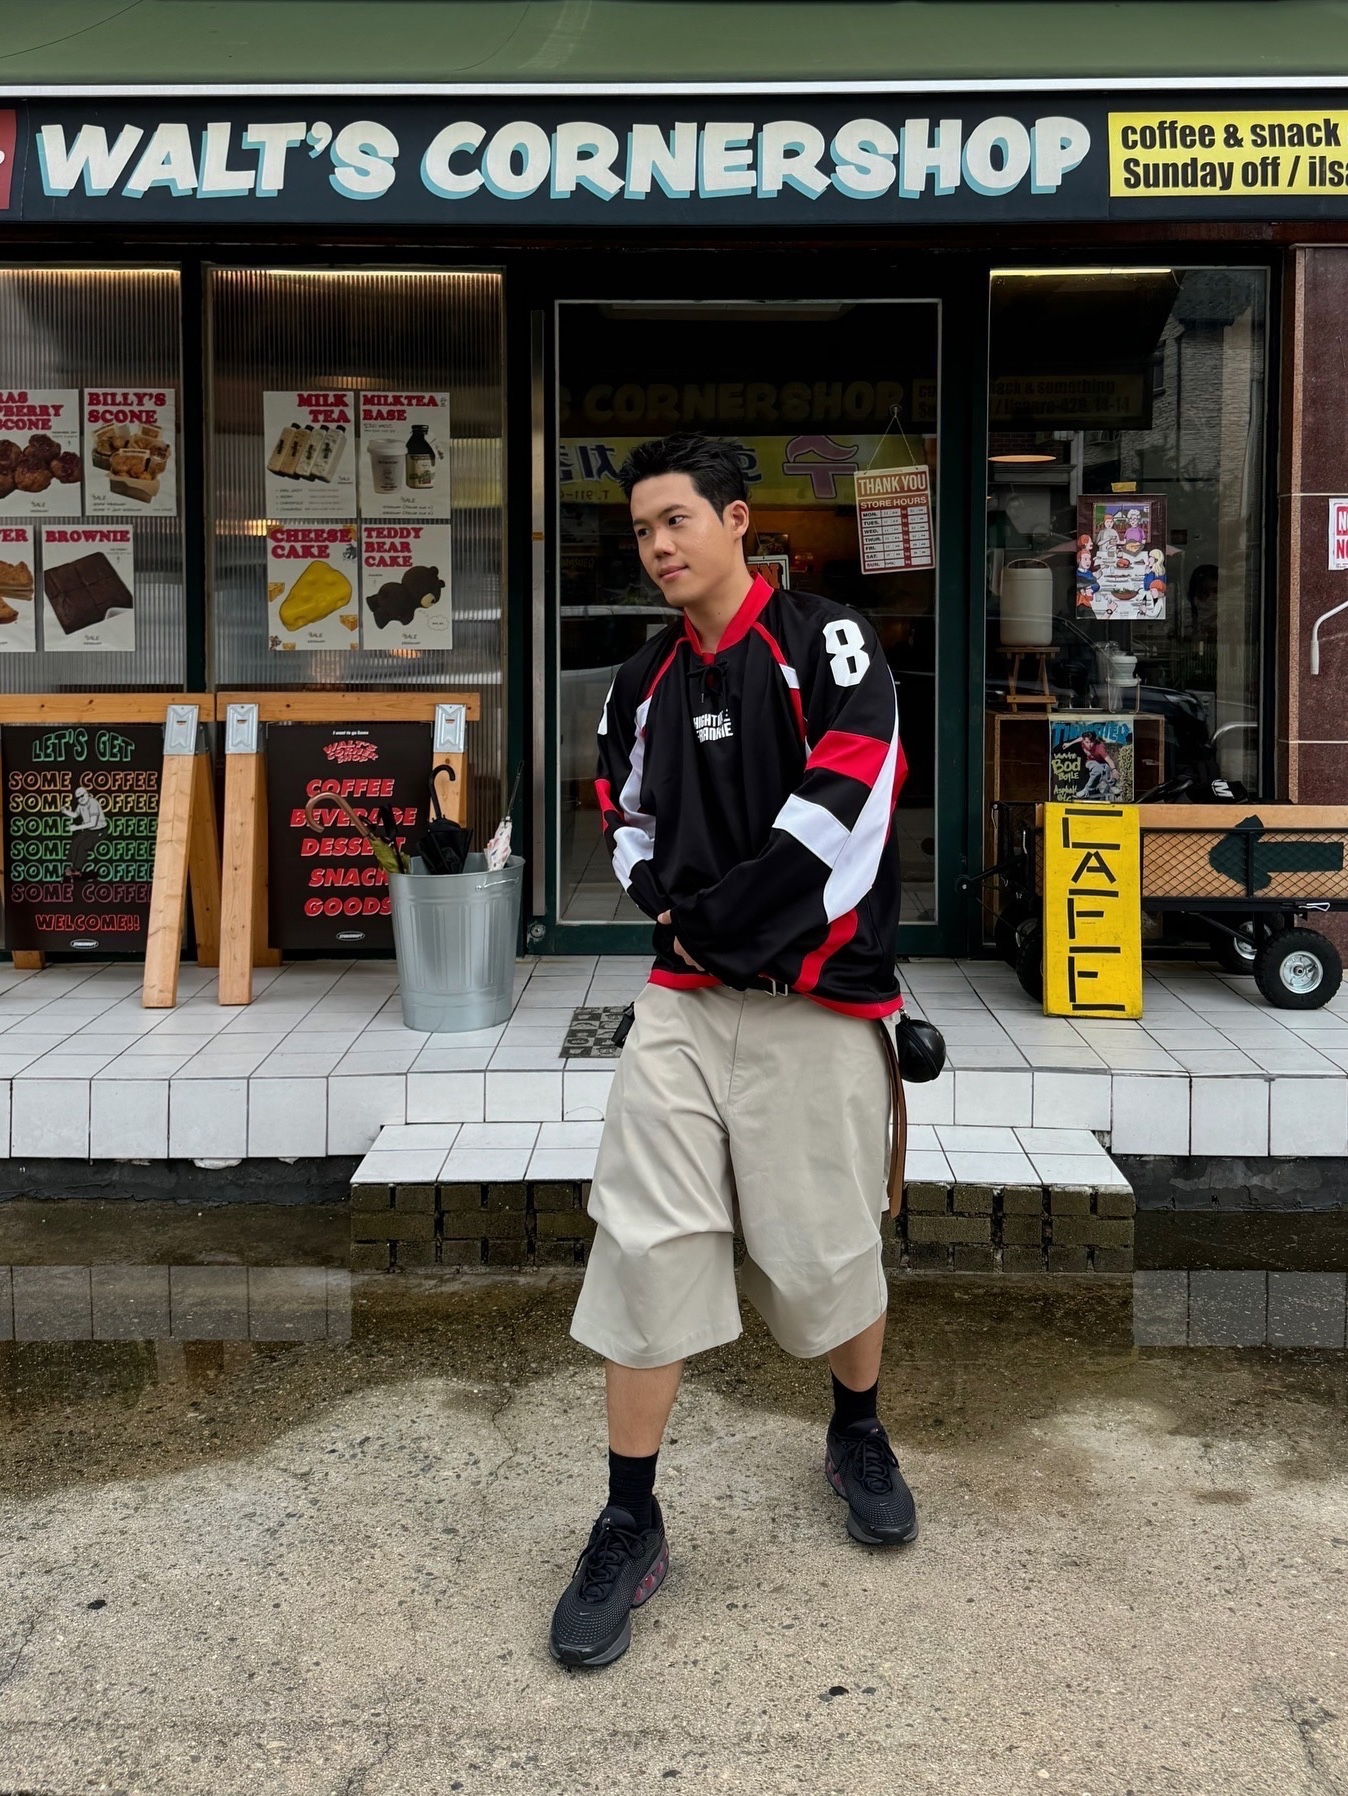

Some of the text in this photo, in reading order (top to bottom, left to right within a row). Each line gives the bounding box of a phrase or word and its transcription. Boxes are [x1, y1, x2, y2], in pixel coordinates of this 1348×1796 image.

[1121, 118, 1341, 150] coffee & snack
[36, 118, 1091, 200] WALT'S CORNERSHOP
[1123, 155, 1348, 191] Sunday off / ils
[87, 392, 167, 407] BILLY'S
[297, 393, 349, 408] MILK
[0, 418, 52, 431] CONE
[87, 410, 158, 424] SCONE
[309, 409, 351, 423] TEA
[362, 409, 407, 421] BASE
[858, 473, 926, 495] THANK YOU
[860, 496, 927, 509] STORE HOURS
[0, 528, 29, 543] ER
[45, 530, 130, 543] BROWNIE
[271, 528, 352, 543] CHEESE
[364, 527, 423, 539] TEDDY
[271, 545, 330, 559] CAKE
[364, 541, 412, 553] BEAR
[1336, 539, 1348, 559] N
[364, 555, 413, 568] CAKE
[822, 618, 870, 687] 8
[32, 728, 135, 762] LET'S GET
[9, 770, 158, 790] SOME COFFEE
[305, 778, 395, 798] COFFEE
[9, 793, 159, 812] SOME OFFEE
[10, 816, 73, 836] SOME
[86, 840, 157, 860] OFFEE
[301, 836, 407, 857] DESSET
[11, 883, 74, 903] SOME
[304, 897, 391, 917] GOODS
[1062, 808, 1126, 1012] CAFE
[35, 914, 140, 931] WELCOME!!
